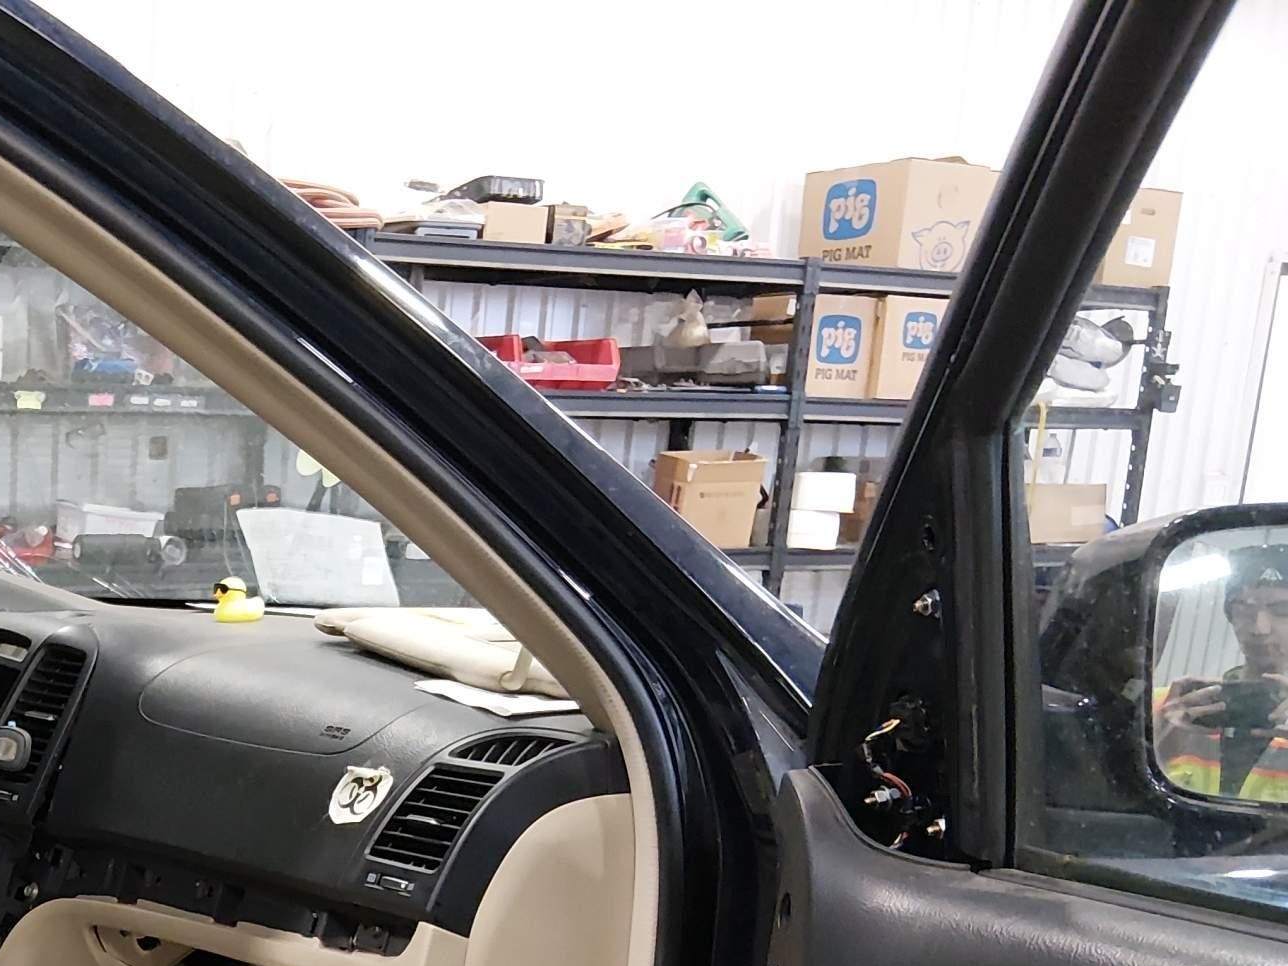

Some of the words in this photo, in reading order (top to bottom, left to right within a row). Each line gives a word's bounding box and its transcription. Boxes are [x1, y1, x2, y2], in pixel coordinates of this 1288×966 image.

[823, 248, 842, 262] PIG
[845, 244, 873, 260] MAT
[815, 368, 833, 380] PIG
[835, 369, 859, 381] MAT
